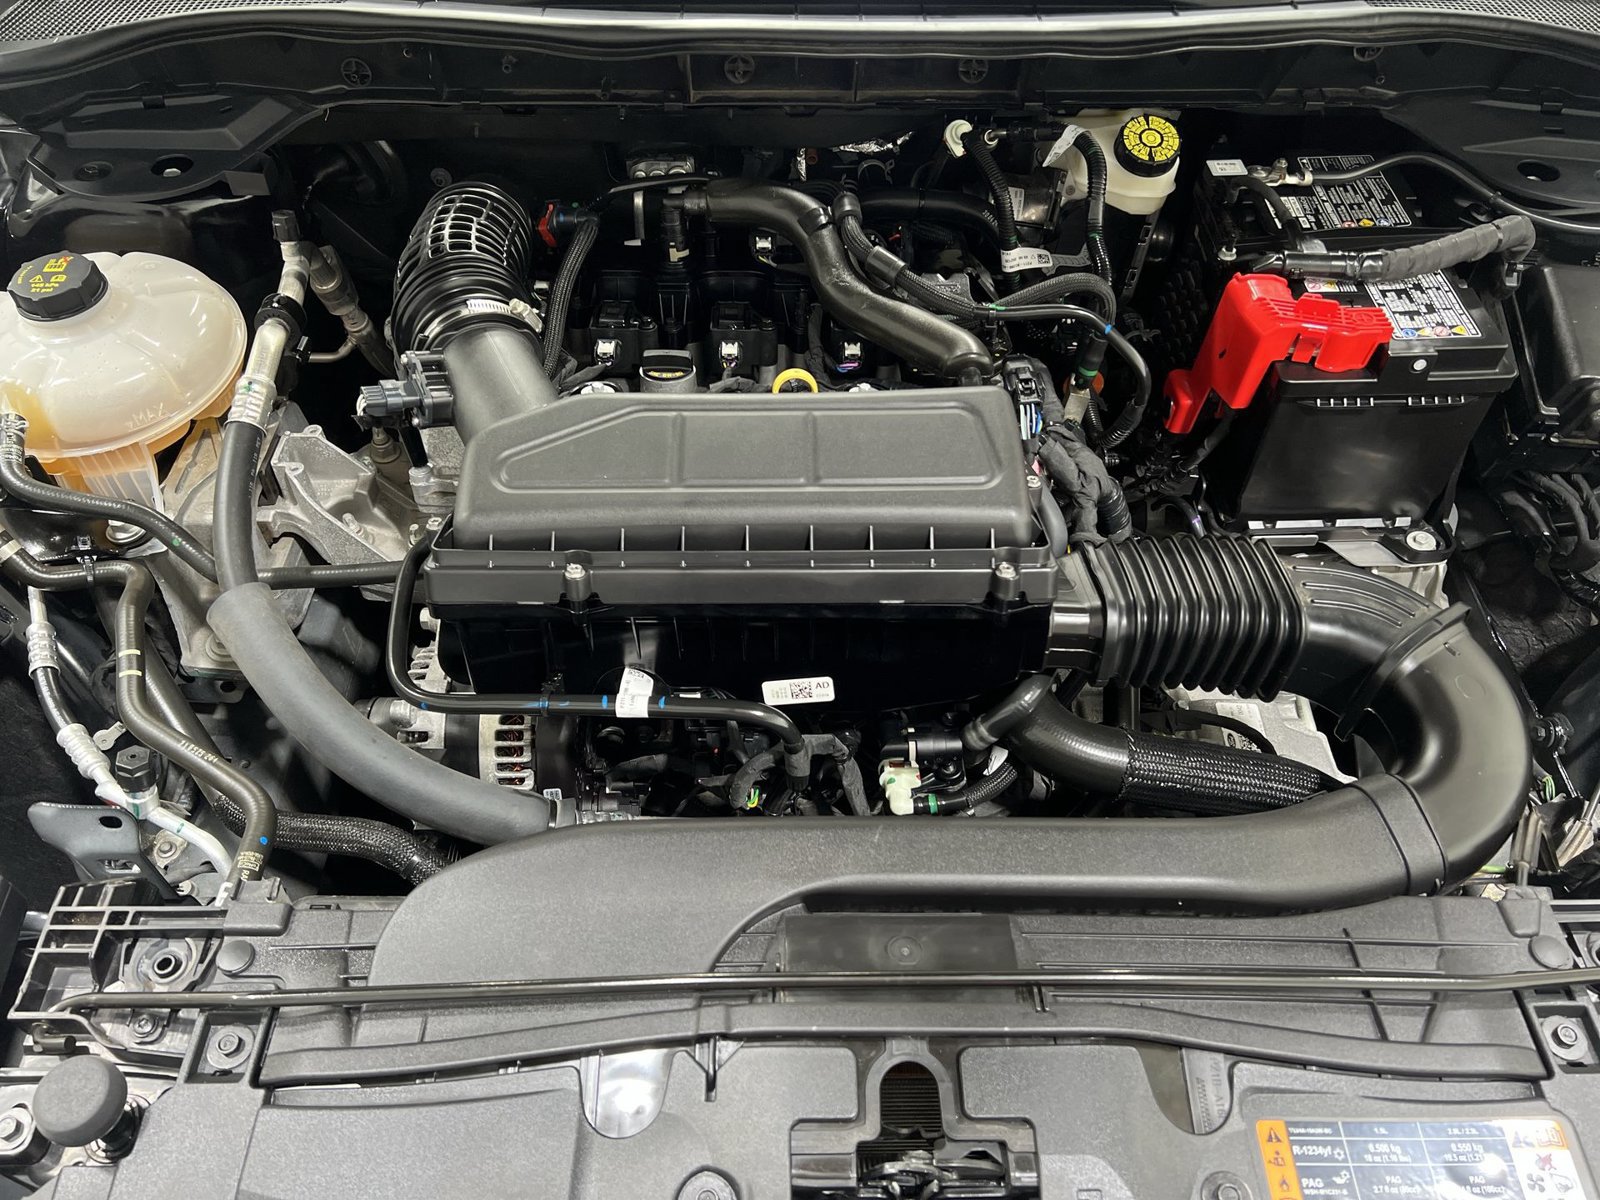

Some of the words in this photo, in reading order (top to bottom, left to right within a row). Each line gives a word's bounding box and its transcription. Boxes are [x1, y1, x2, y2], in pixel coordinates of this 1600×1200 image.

[816, 681, 830, 689] AD
[1368, 1143, 1390, 1152] 0.500
[1390, 1143, 1402, 1154] kg
[1451, 1143, 1472, 1152] 0.550
[1472, 1143, 1484, 1153] kg
[1301, 1177, 1324, 1188] PAG
[1385, 1176, 1402, 1184] PAG
[1468, 1176, 1486, 1184] PAG
